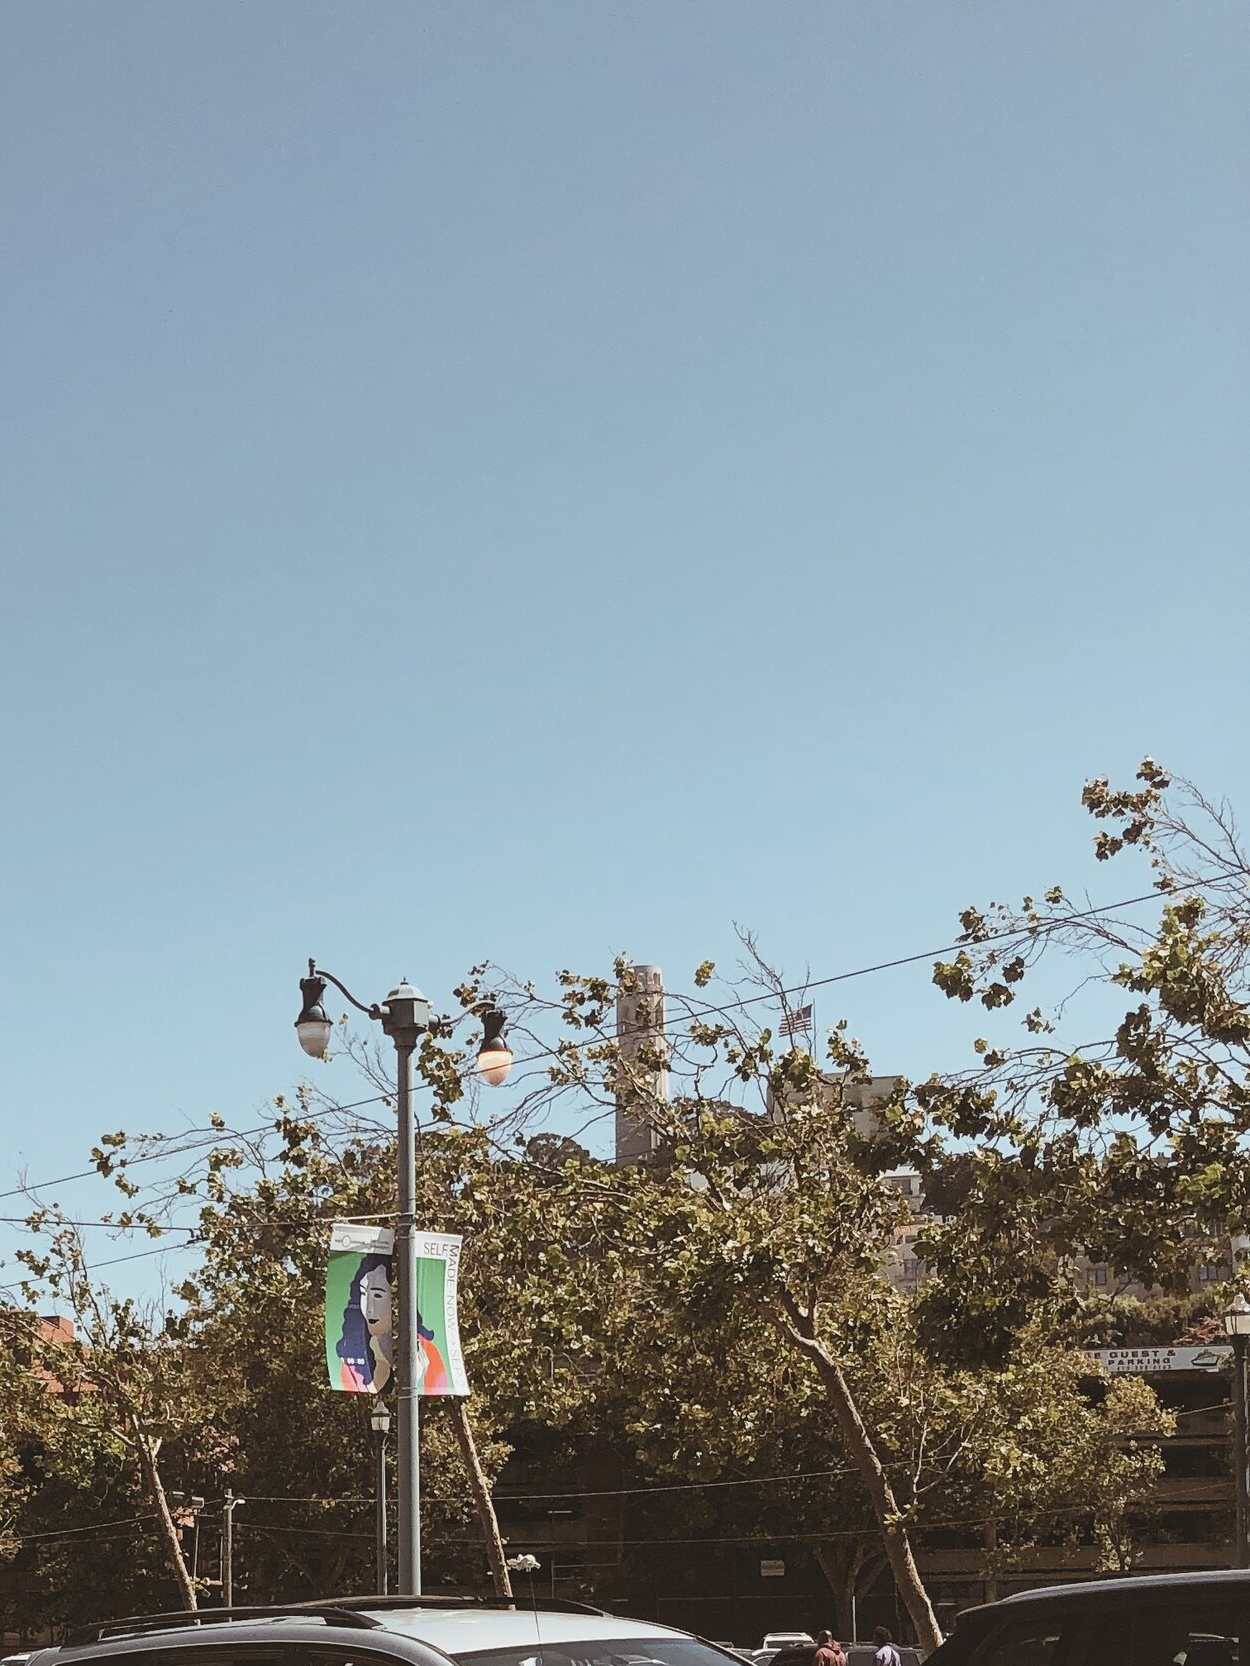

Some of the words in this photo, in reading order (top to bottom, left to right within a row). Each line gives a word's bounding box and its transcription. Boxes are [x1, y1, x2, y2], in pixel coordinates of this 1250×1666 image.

[447, 1244, 460, 1287] MADE
[447, 1295, 456, 1329] NOW
[1108, 1358, 1171, 1366] PARKING
[1109, 1350, 1160, 1359] GUEST
[1166, 1349, 1176, 1357] &
